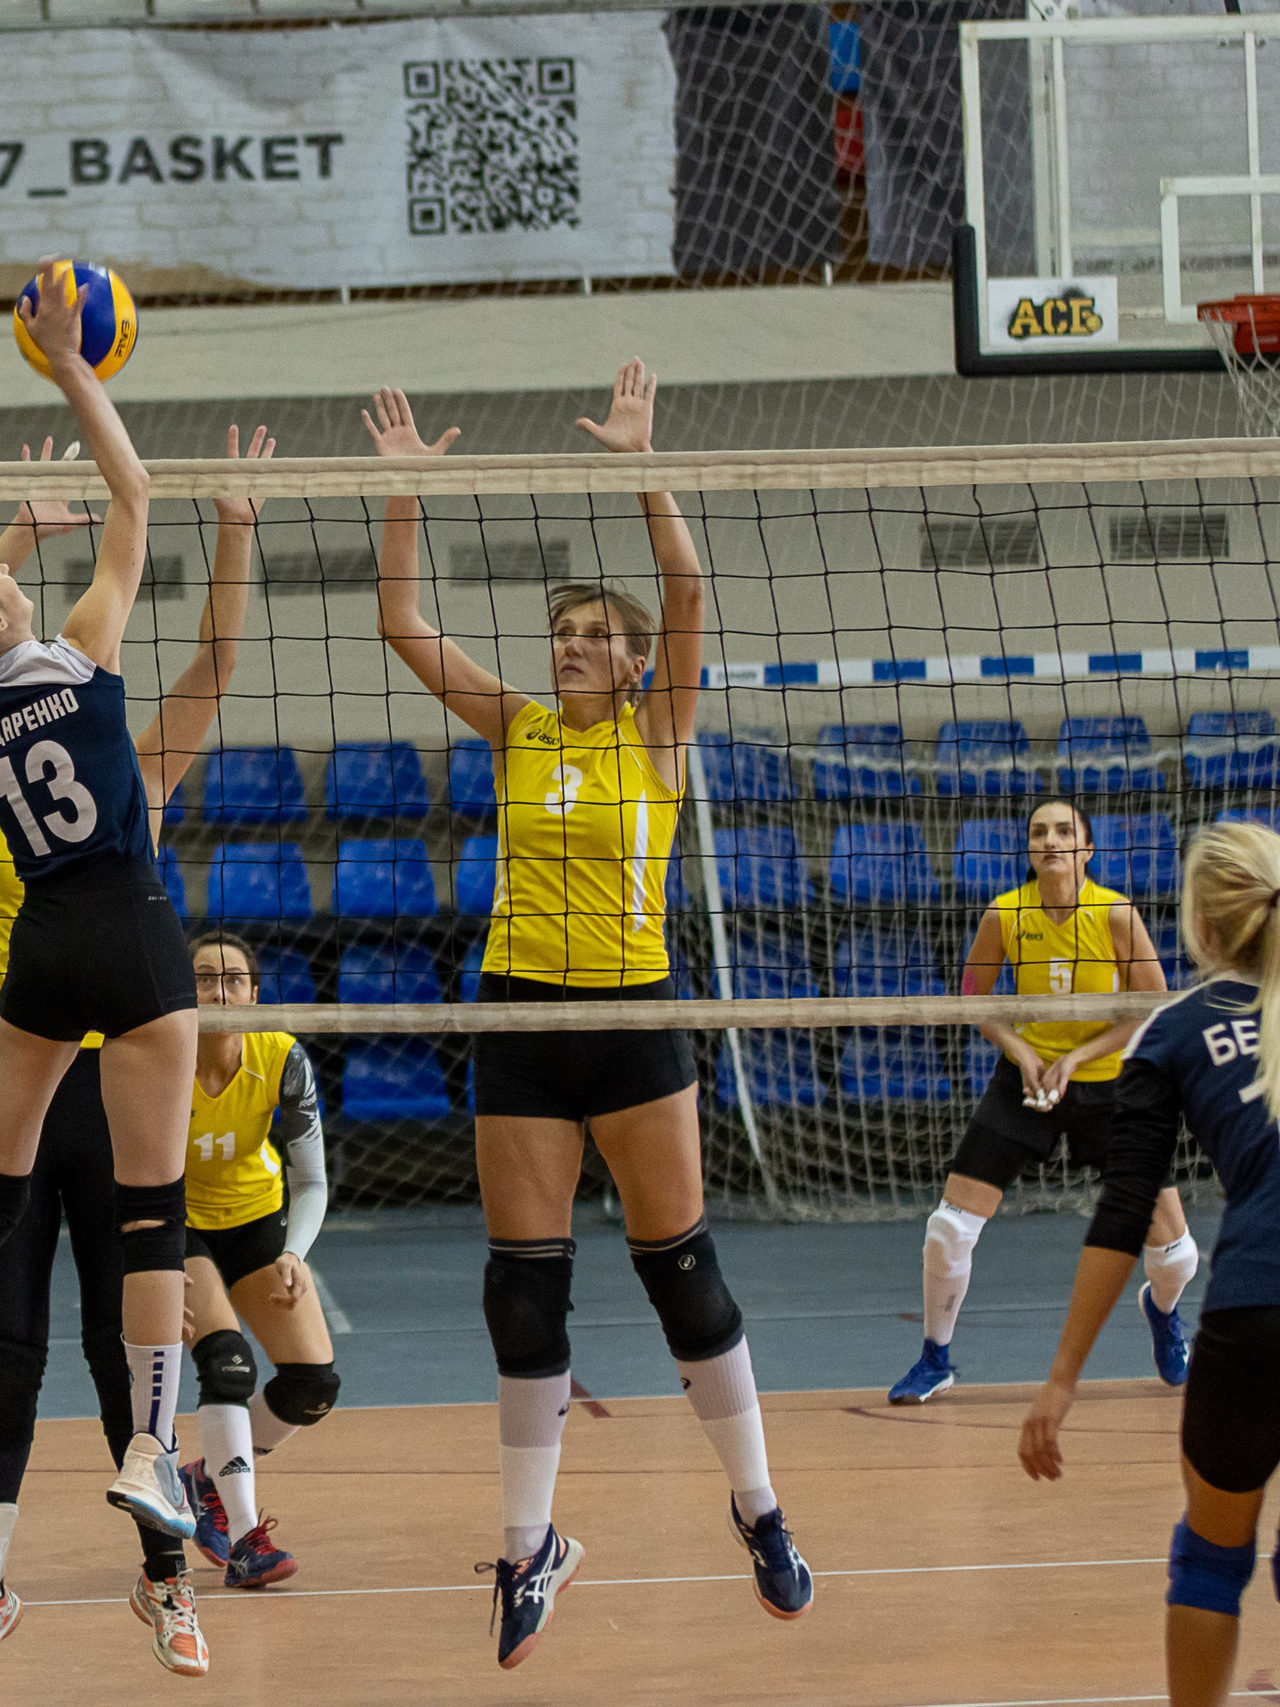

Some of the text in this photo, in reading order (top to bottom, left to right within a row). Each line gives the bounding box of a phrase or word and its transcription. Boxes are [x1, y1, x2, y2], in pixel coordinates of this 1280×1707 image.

[1009, 297, 1096, 339] ACE
[544, 763, 584, 816] 3
[1049, 956, 1072, 994] 5
[193, 1131, 237, 1162] 11
